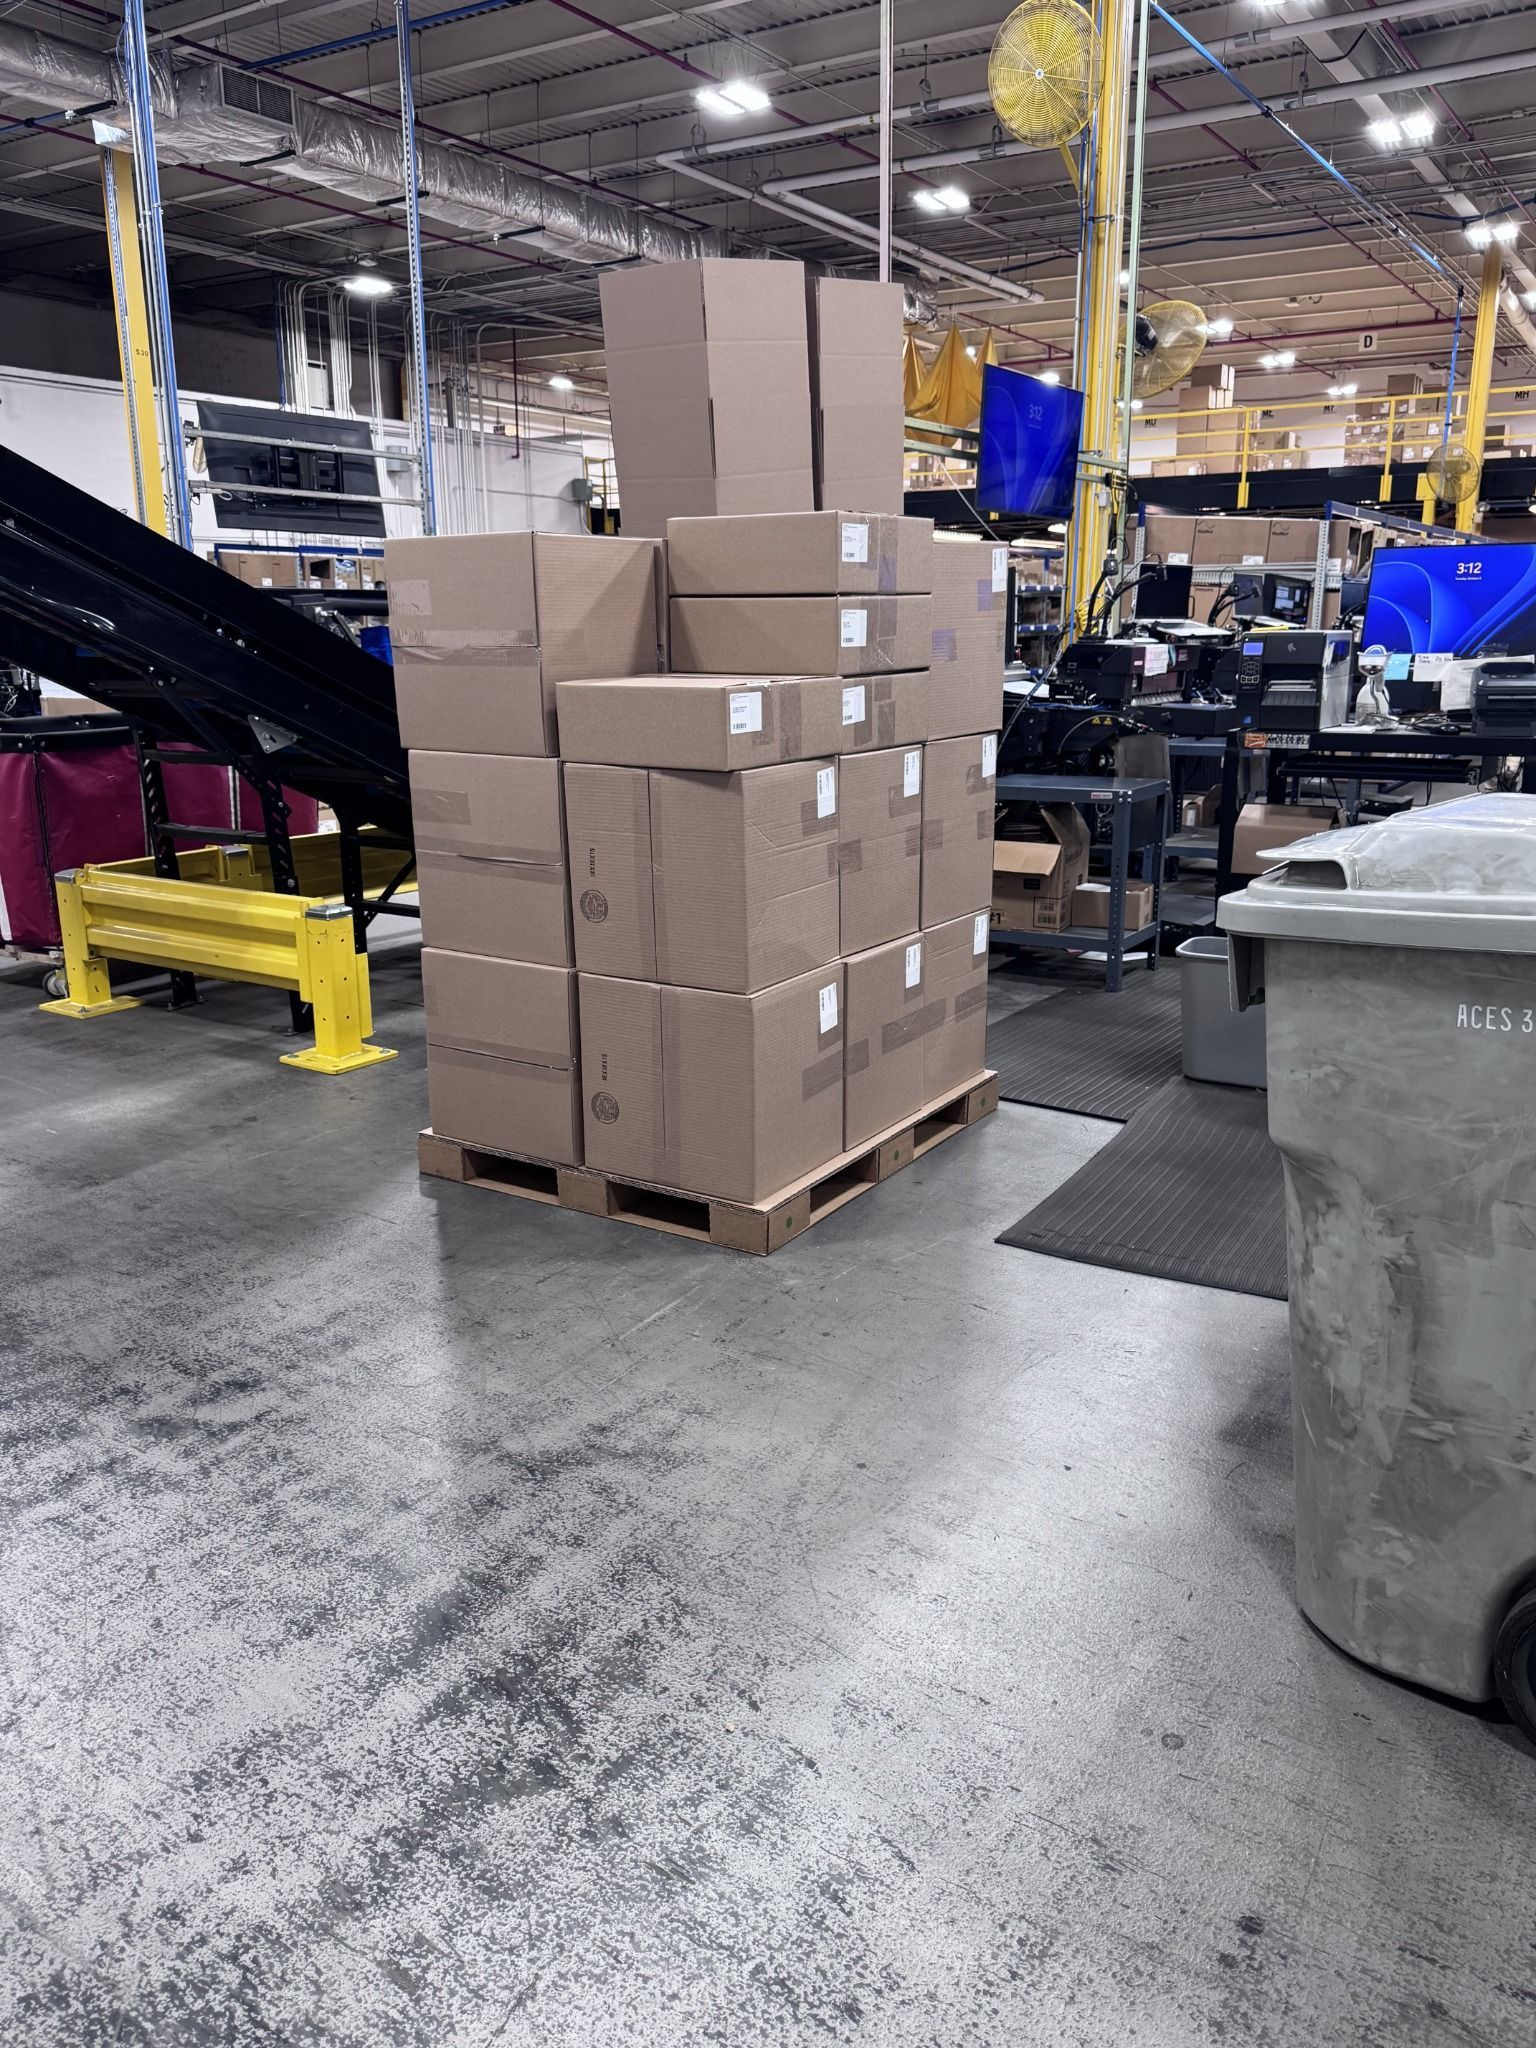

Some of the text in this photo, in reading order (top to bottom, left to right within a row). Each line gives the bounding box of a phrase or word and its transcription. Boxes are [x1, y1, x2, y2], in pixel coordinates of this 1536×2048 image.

[1363, 335, 1373, 349] D
[1456, 562, 1482, 575] 3:12
[1456, 1004, 1513, 1032] ACES
